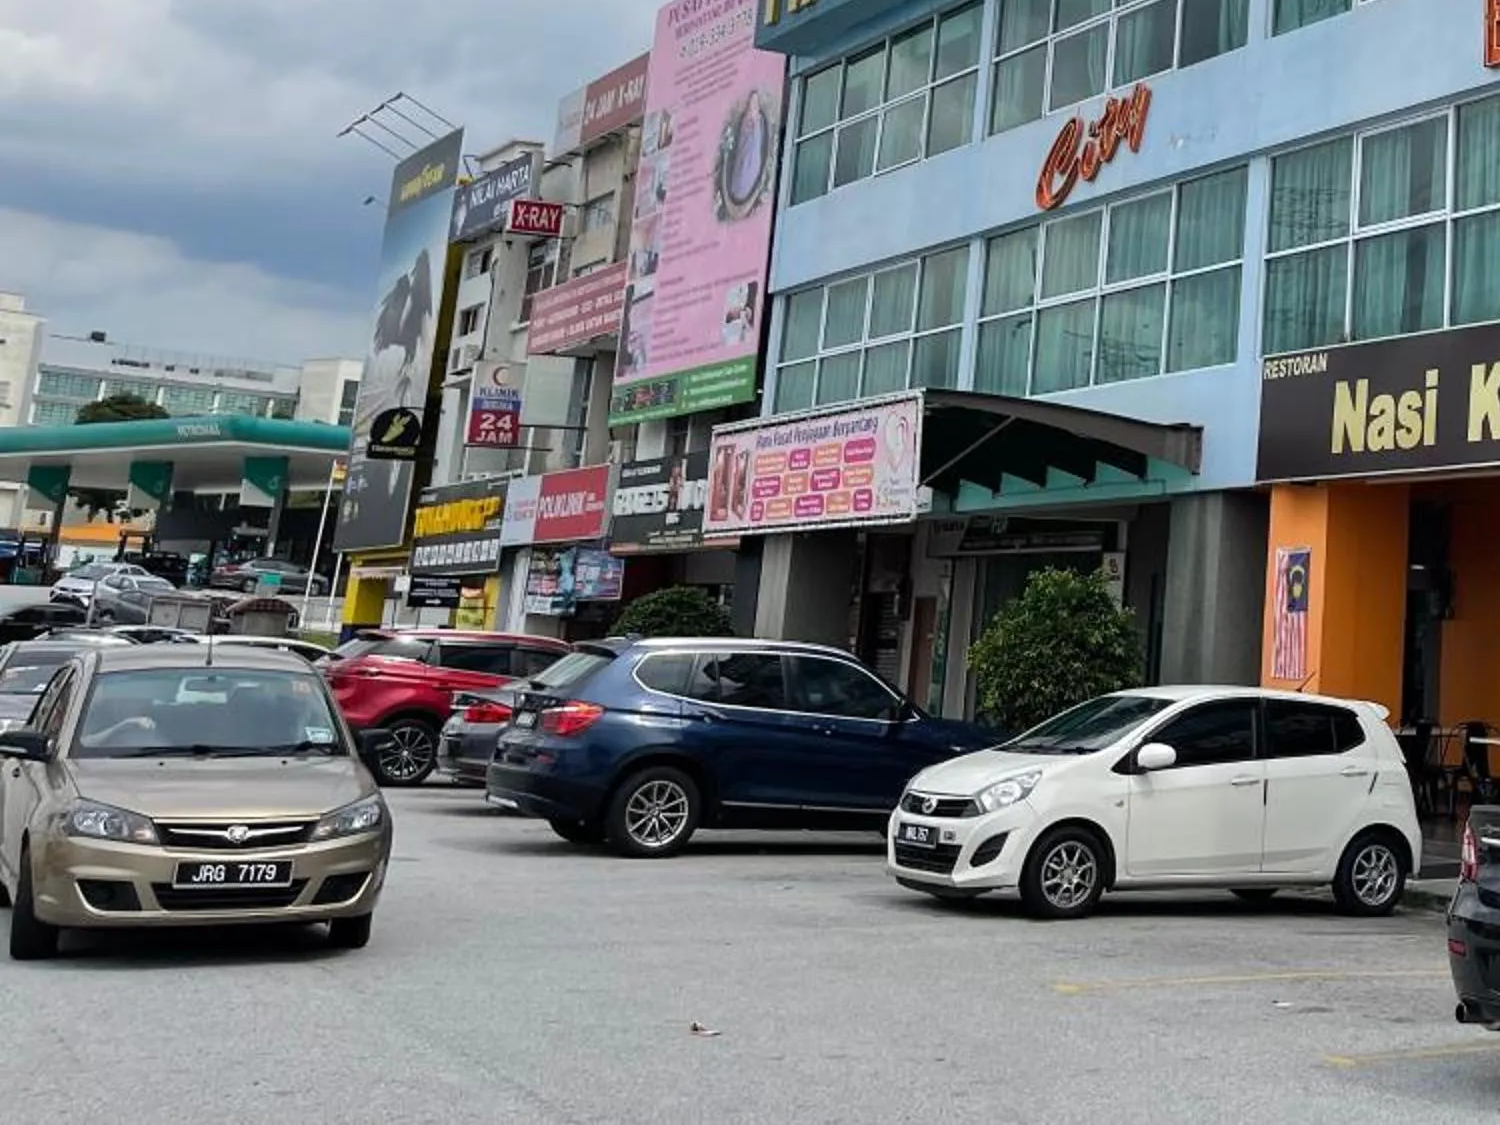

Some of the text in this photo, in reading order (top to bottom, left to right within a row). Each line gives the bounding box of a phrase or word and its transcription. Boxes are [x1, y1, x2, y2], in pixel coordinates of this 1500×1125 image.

[1036, 83, 1152, 211] City
[497, 164, 530, 197] HARTA
[515, 204, 560, 230] X-RAY
[1263, 353, 1328, 379] RESTORAN
[479, 413, 513, 430] 24
[1332, 368, 1440, 455] Nasi
[475, 431, 512, 443] JAM
[191, 863, 277, 882] JRG 7179
